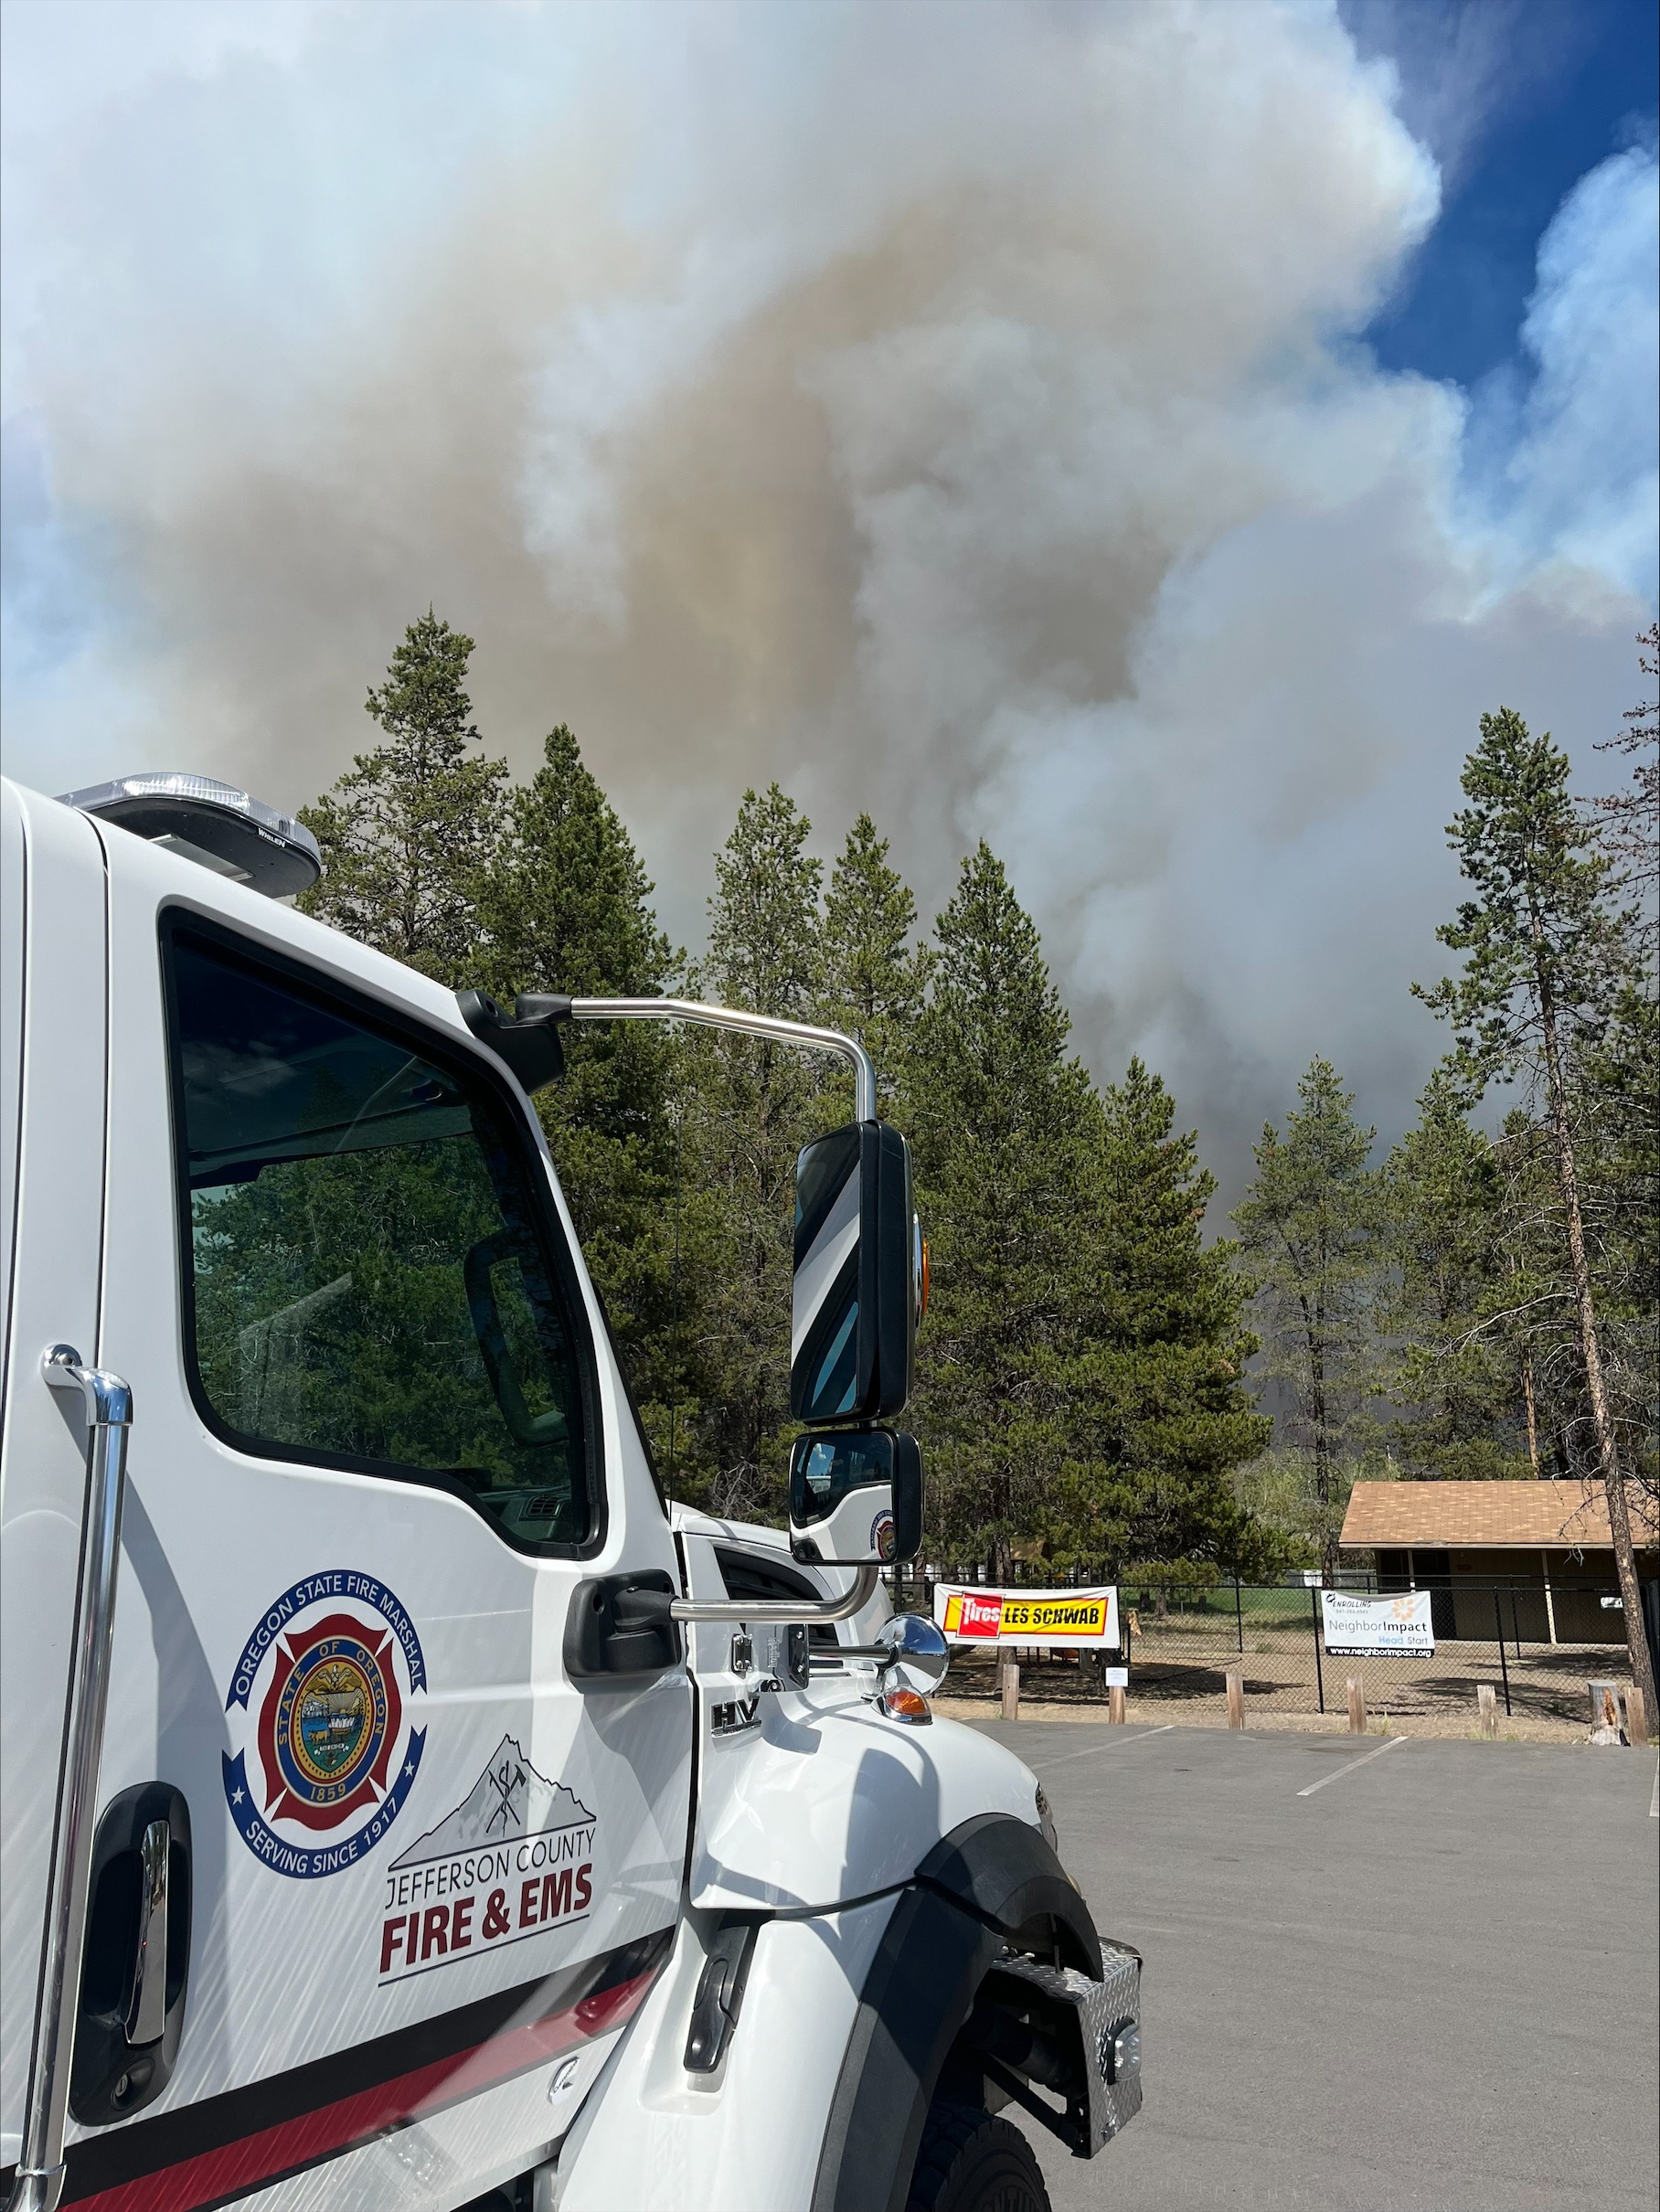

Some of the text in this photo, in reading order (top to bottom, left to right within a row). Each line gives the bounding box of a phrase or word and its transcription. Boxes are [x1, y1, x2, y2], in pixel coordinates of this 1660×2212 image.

[963, 1599, 1000, 1624] Tires
[1005, 1608, 1099, 1624] LES SCHWAB
[1330, 1621, 1427, 1632] NeighborImpact
[235, 1575, 423, 1696] OREGON STATE FIRE MARSHAL
[1331, 1647, 1431, 1657] www.neighborimpact.org
[278, 1642, 385, 1745] STATE OF OREGON
[710, 1696, 760, 1730] HV
[310, 1783, 346, 1803] 1859
[246, 1797, 398, 1874] SERVING SINCE 1917
[385, 1828, 597, 1909] JEFFERSON COUNTY
[380, 1864, 592, 1973] FIRE & EMS
